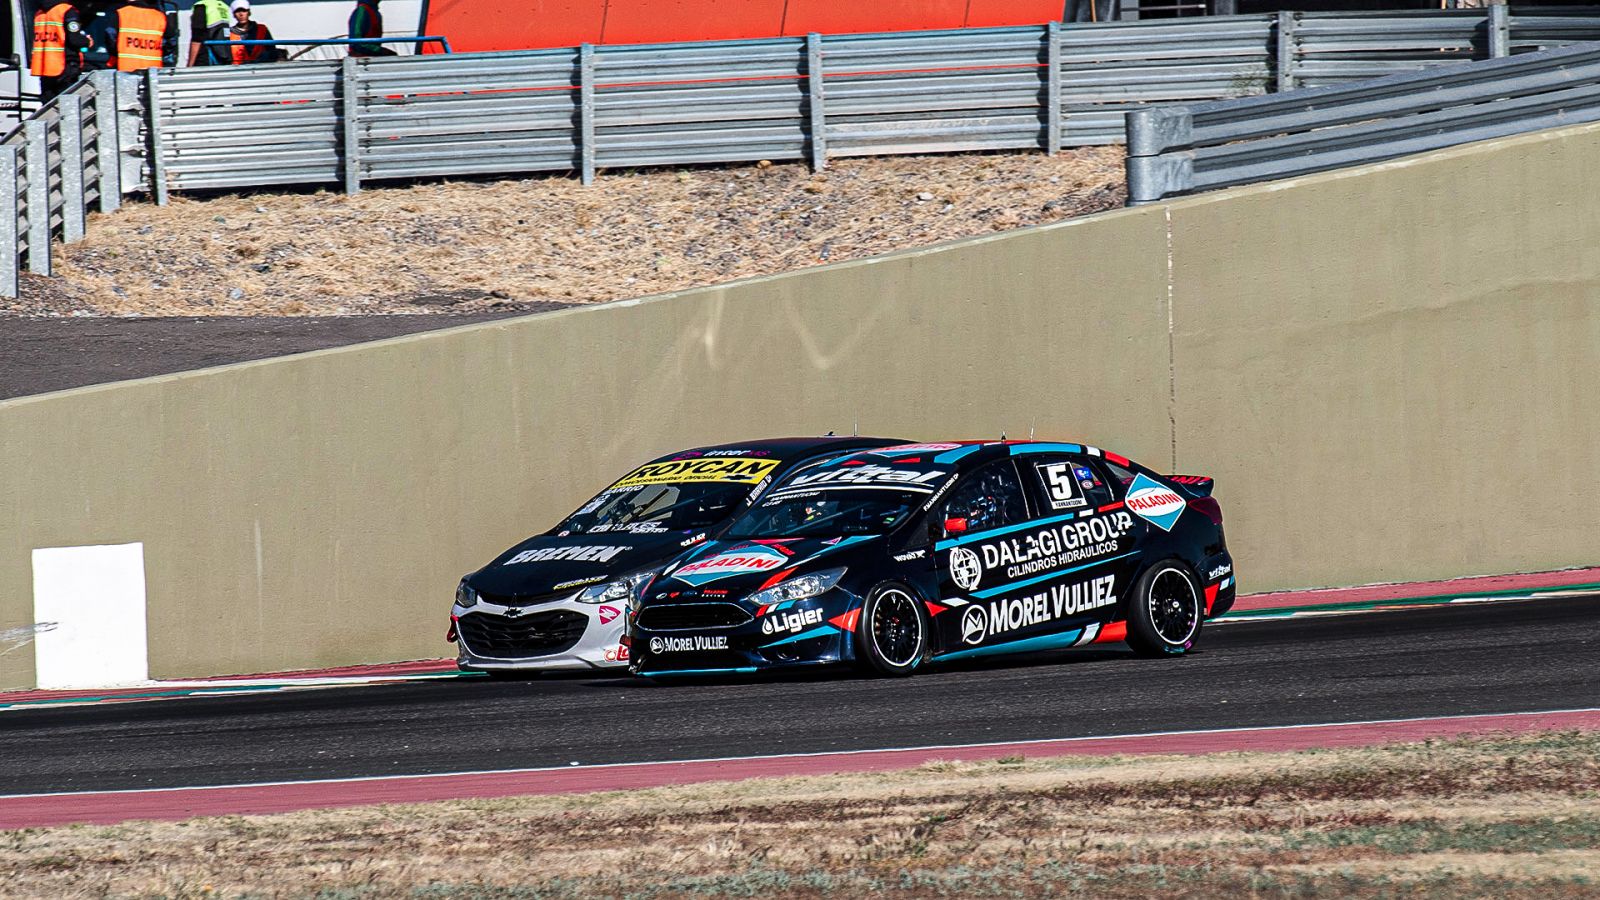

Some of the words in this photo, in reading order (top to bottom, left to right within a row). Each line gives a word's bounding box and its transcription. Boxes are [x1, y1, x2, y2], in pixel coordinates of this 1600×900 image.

[625, 460, 777, 480] ROYCAN
[1046, 464, 1073, 500] 5
[1127, 493, 1183, 511] PALADINI
[1062, 511, 1134, 546] GROUP
[503, 545, 627, 566] BREMEN
[676, 556, 781, 575] PALADINI
[1007, 555, 1057, 578] CILINDROS
[1058, 540, 1119, 564] HIDRAULICOS
[989, 591, 1051, 635] MOREL
[1051, 574, 1117, 619] VULLIEZ
[773, 607, 824, 633] Ligier
[664, 636, 695, 652] MOREL
